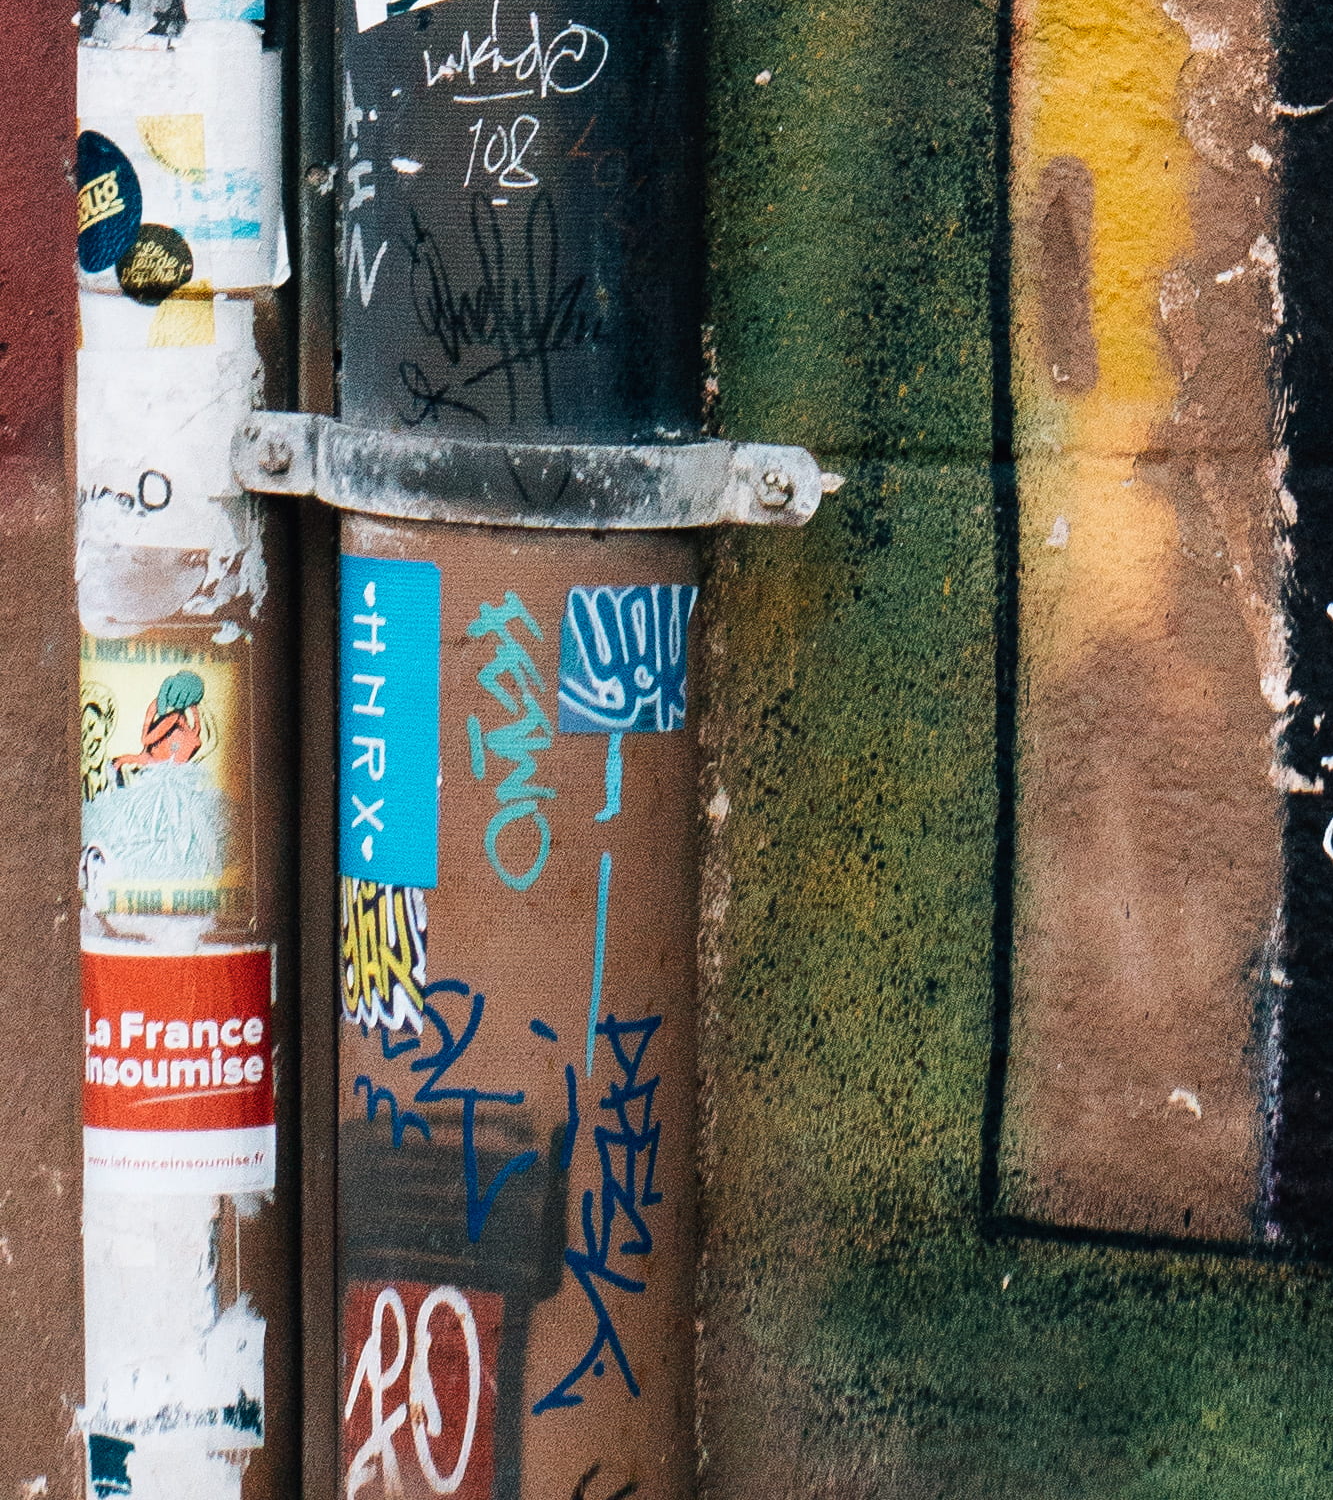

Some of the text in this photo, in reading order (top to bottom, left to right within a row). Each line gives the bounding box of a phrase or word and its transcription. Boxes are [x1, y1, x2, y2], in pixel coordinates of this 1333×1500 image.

[350, 612, 387, 830] HNRX
[120, 1010, 265, 1051] France
[85, 1046, 265, 1089] insoumise
